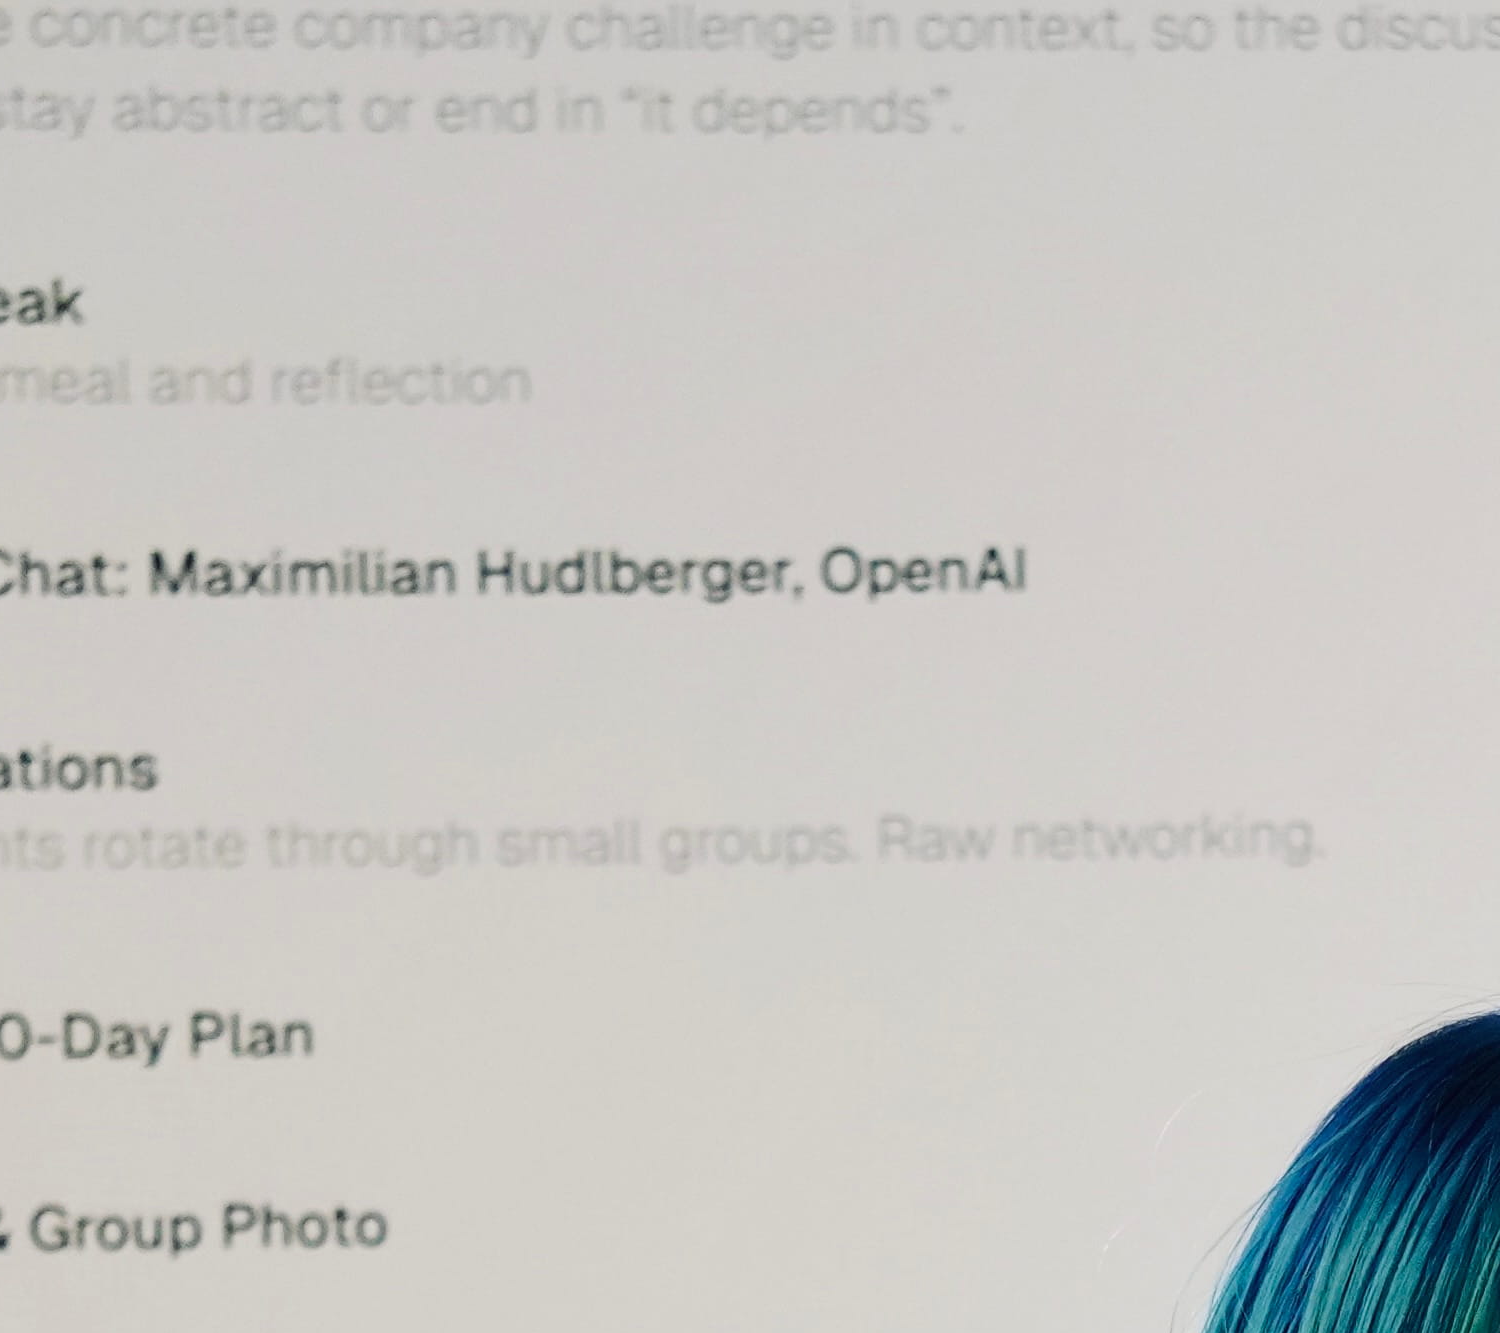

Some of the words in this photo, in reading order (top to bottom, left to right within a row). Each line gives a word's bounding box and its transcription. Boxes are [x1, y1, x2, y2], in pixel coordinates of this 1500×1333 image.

[28, 5, 278, 50] concrete
[292, 9, 550, 60] company
[565, 3, 836, 62] challenge
[851, 6, 900, 49] in
[915, 7, 1136, 56] context,
[1151, 12, 1217, 53] so
[1232, 5, 1322, 54] the
[111, 84, 344, 134] abstract
[360, 93, 416, 134] or
[433, 87, 539, 135] end
[556, 86, 605, 132] in
[147, 358, 253, 406] and
[270, 355, 533, 407] reflection
[149, 549, 457, 598] Maximilian
[477, 549, 804, 605] Hudlberger,
[820, 545, 1026, 600] OpenAI
[82, 825, 249, 871] rotate
[263, 820, 480, 878] through
[495, 817, 643, 869] small
[657, 824, 860, 876] groups.
[876, 812, 997, 863] Raw
[1012, 812, 1326, 870] networking.
[189, 1009, 314, 1059] Plan
[28, 1203, 203, 1259] Group
[222, 1200, 389, 1249] Photo
